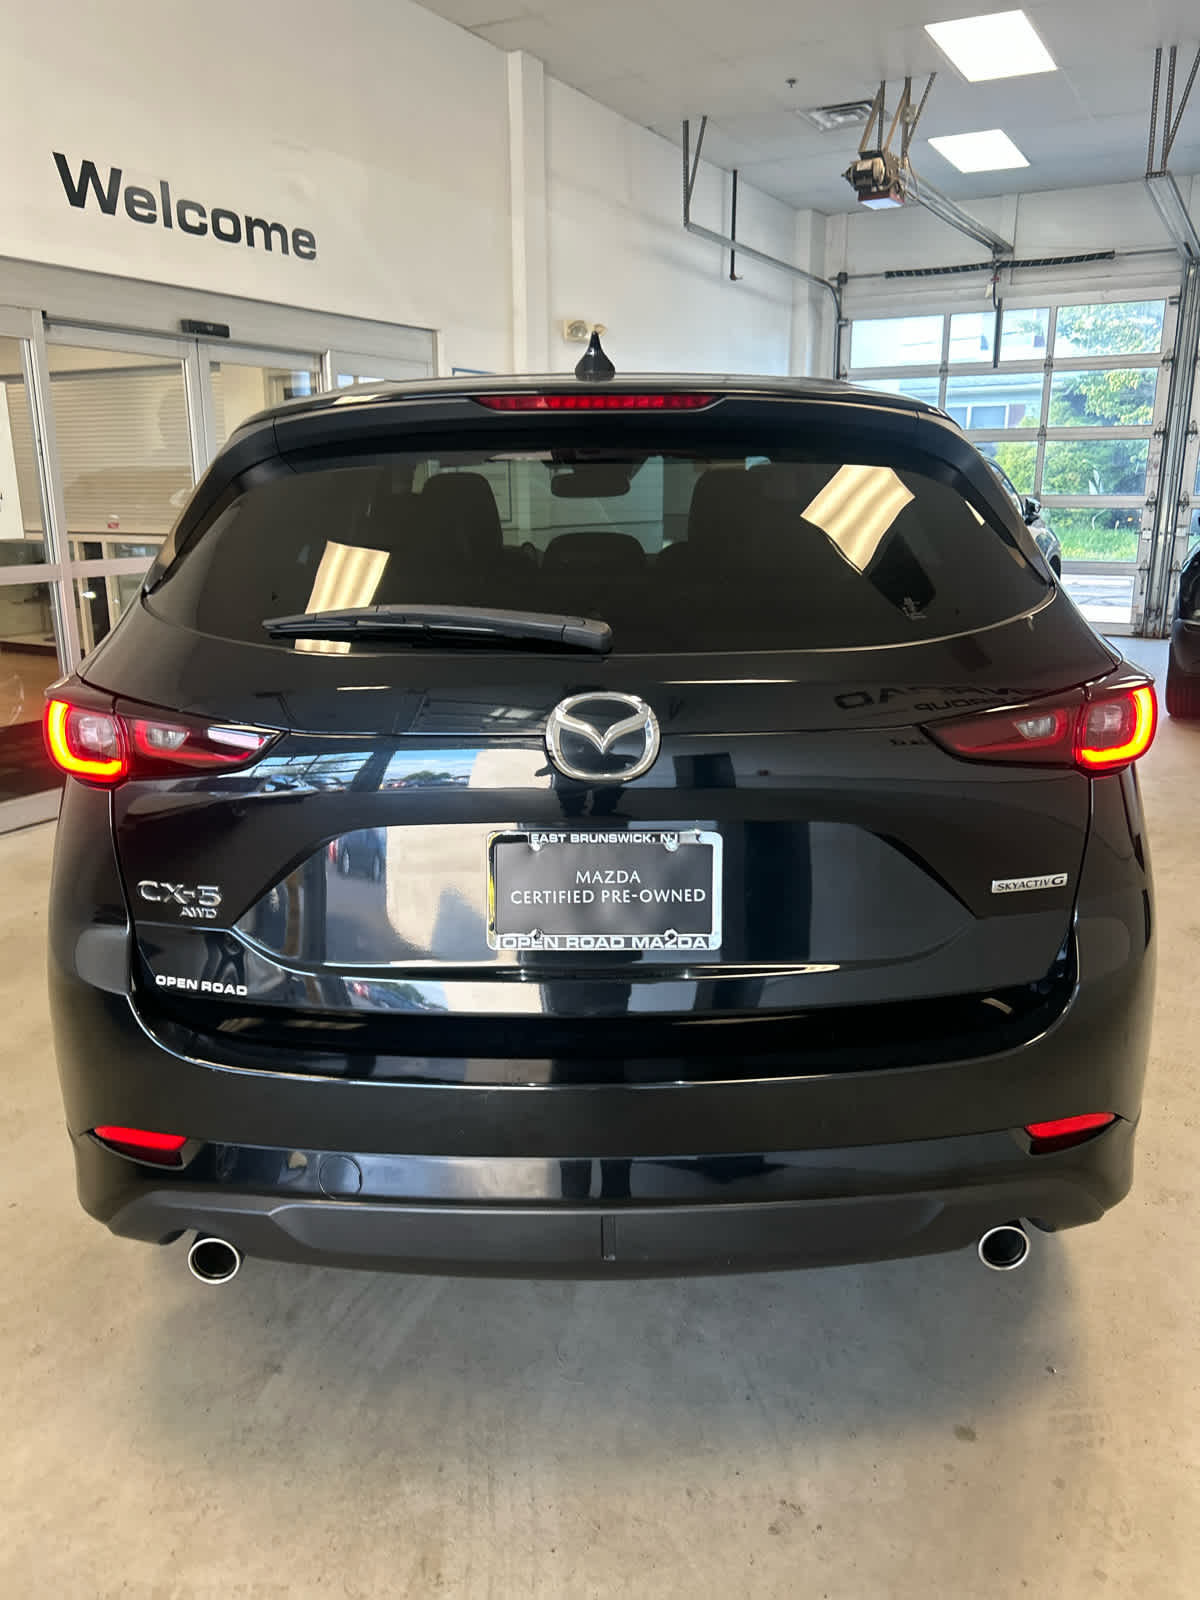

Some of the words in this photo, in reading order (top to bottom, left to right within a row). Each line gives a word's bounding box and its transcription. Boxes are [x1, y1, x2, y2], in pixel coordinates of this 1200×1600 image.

[52, 151, 317, 261] Welcome
[531, 833, 567, 844] EAST
[570, 833, 655, 844] BRUNSWICK,
[660, 833, 679, 845] NJ
[575, 870, 641, 884] MAZDA
[137, 880, 222, 907] CX-5
[511, 890, 595, 904] CERTIFIED
[601, 888, 706, 904] PRE-OWNED
[180, 906, 218, 919] AWD
[502, 936, 559, 950] OPEN
[566, 936, 625, 950] ROAD
[632, 936, 709, 950] MAZDA
[155, 974, 198, 990] OPEN
[200, 980, 249, 996] ROAD
